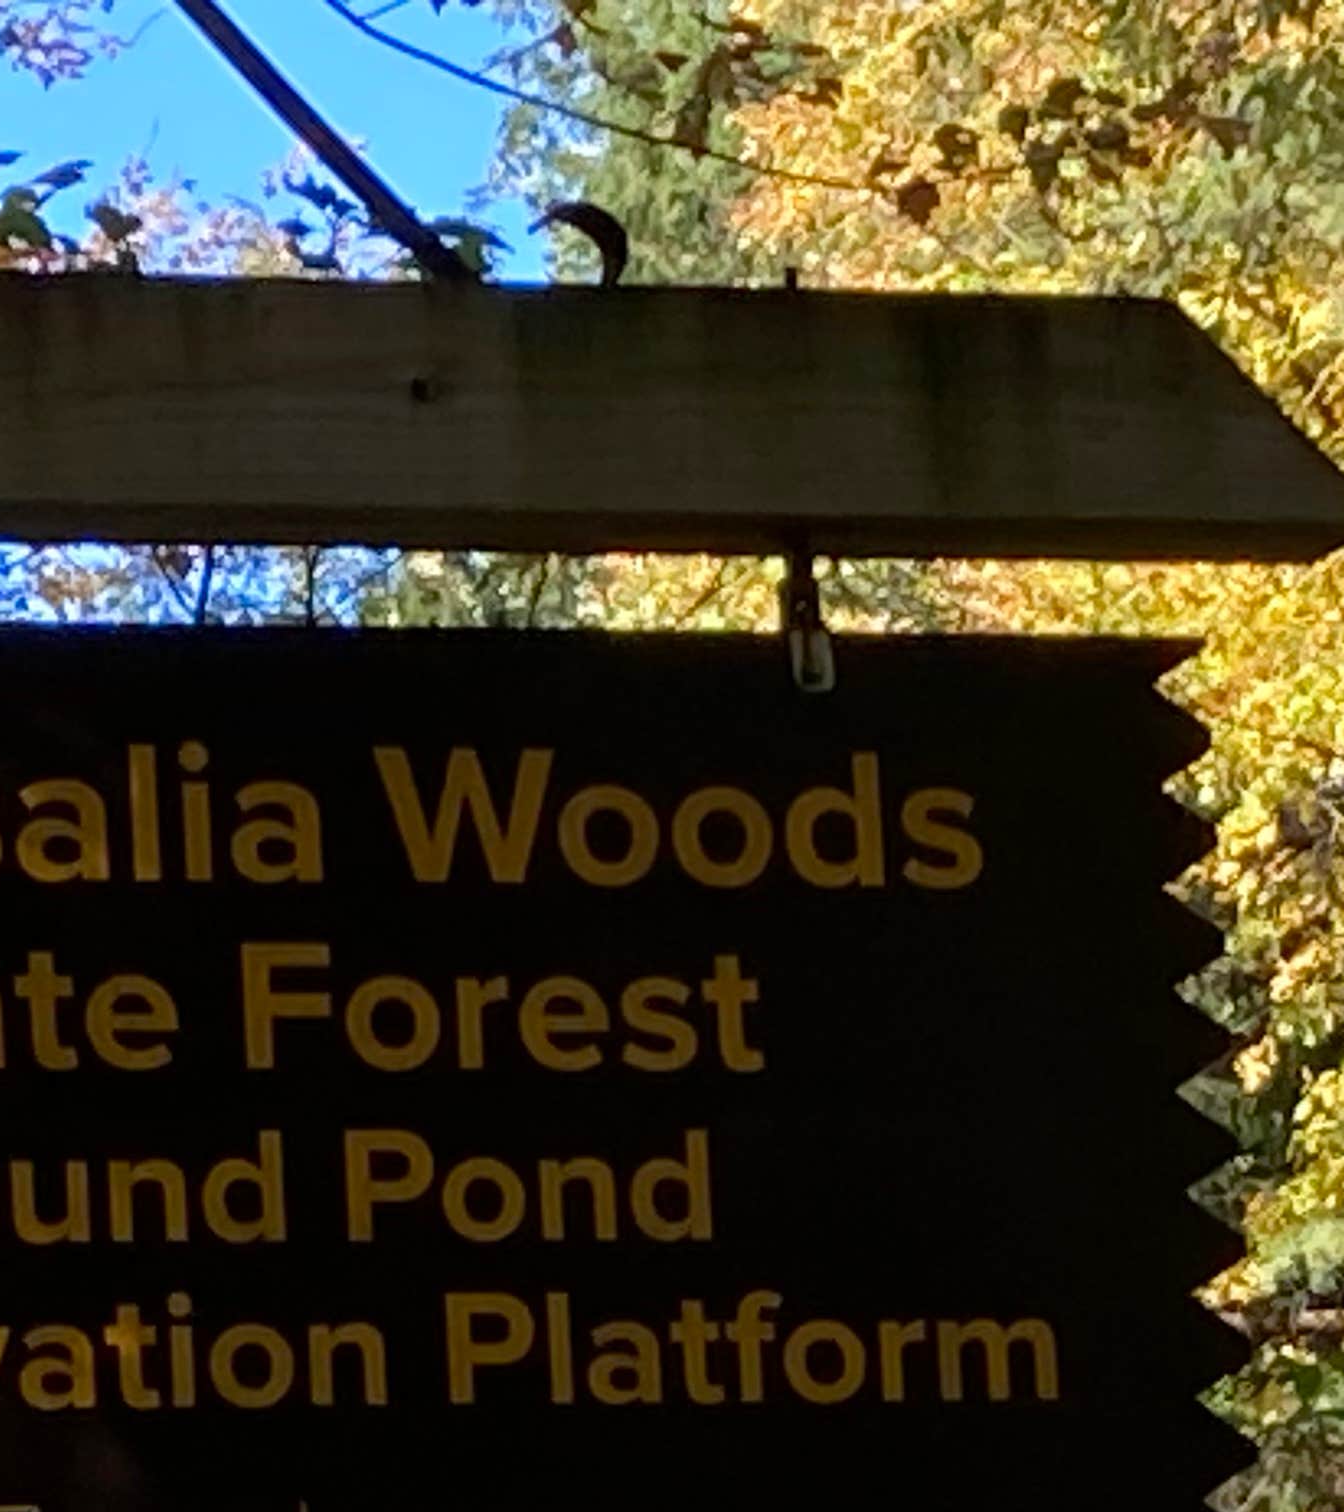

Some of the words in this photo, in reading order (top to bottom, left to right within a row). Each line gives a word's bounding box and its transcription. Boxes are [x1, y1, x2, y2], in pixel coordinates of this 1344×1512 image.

[373, 747, 983, 889] Woods
[241, 942, 764, 1072] Forest
[344, 1129, 712, 1242] Pond
[445, 1290, 1058, 1404] Platform
